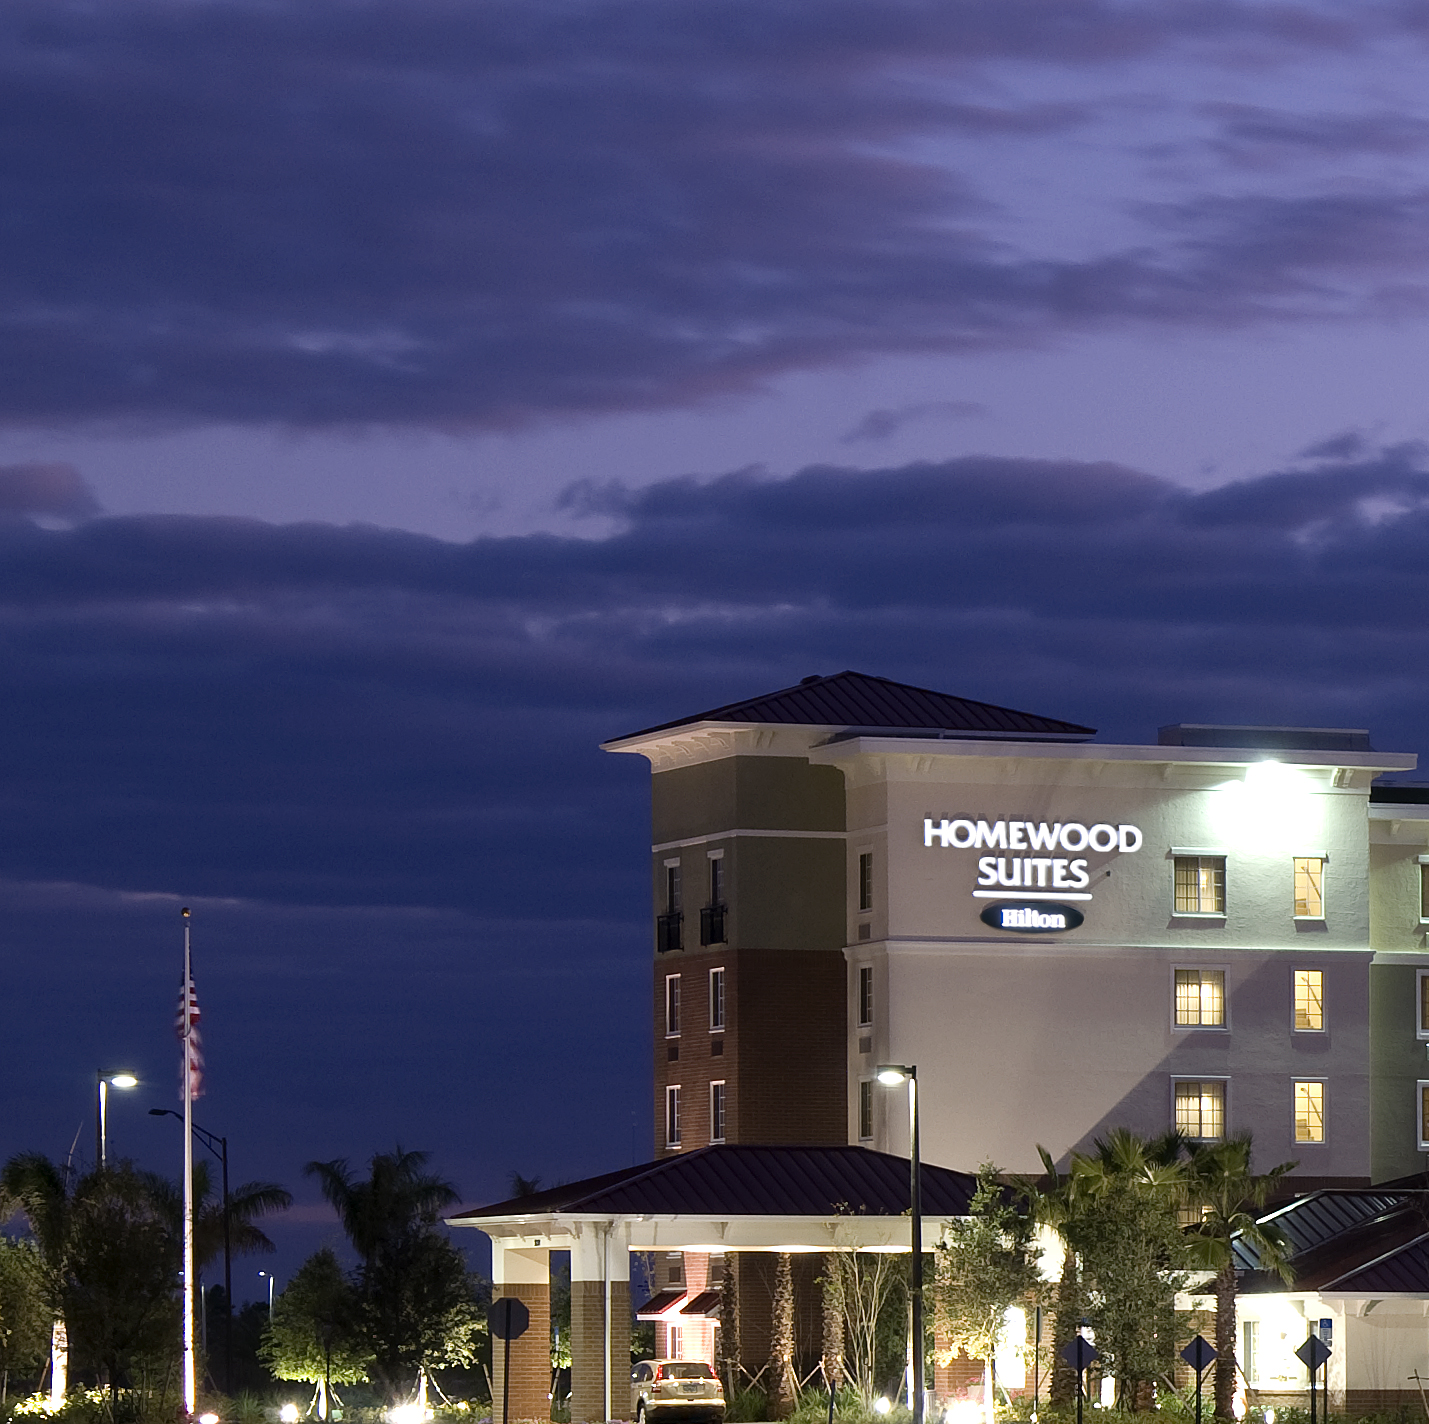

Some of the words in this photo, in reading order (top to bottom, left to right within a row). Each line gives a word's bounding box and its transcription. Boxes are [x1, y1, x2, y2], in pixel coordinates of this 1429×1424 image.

[923, 818, 1143, 853] HOMEWOOD
[977, 856, 1090, 889] SUITES
[1001, 907, 1066, 928] Hilton
